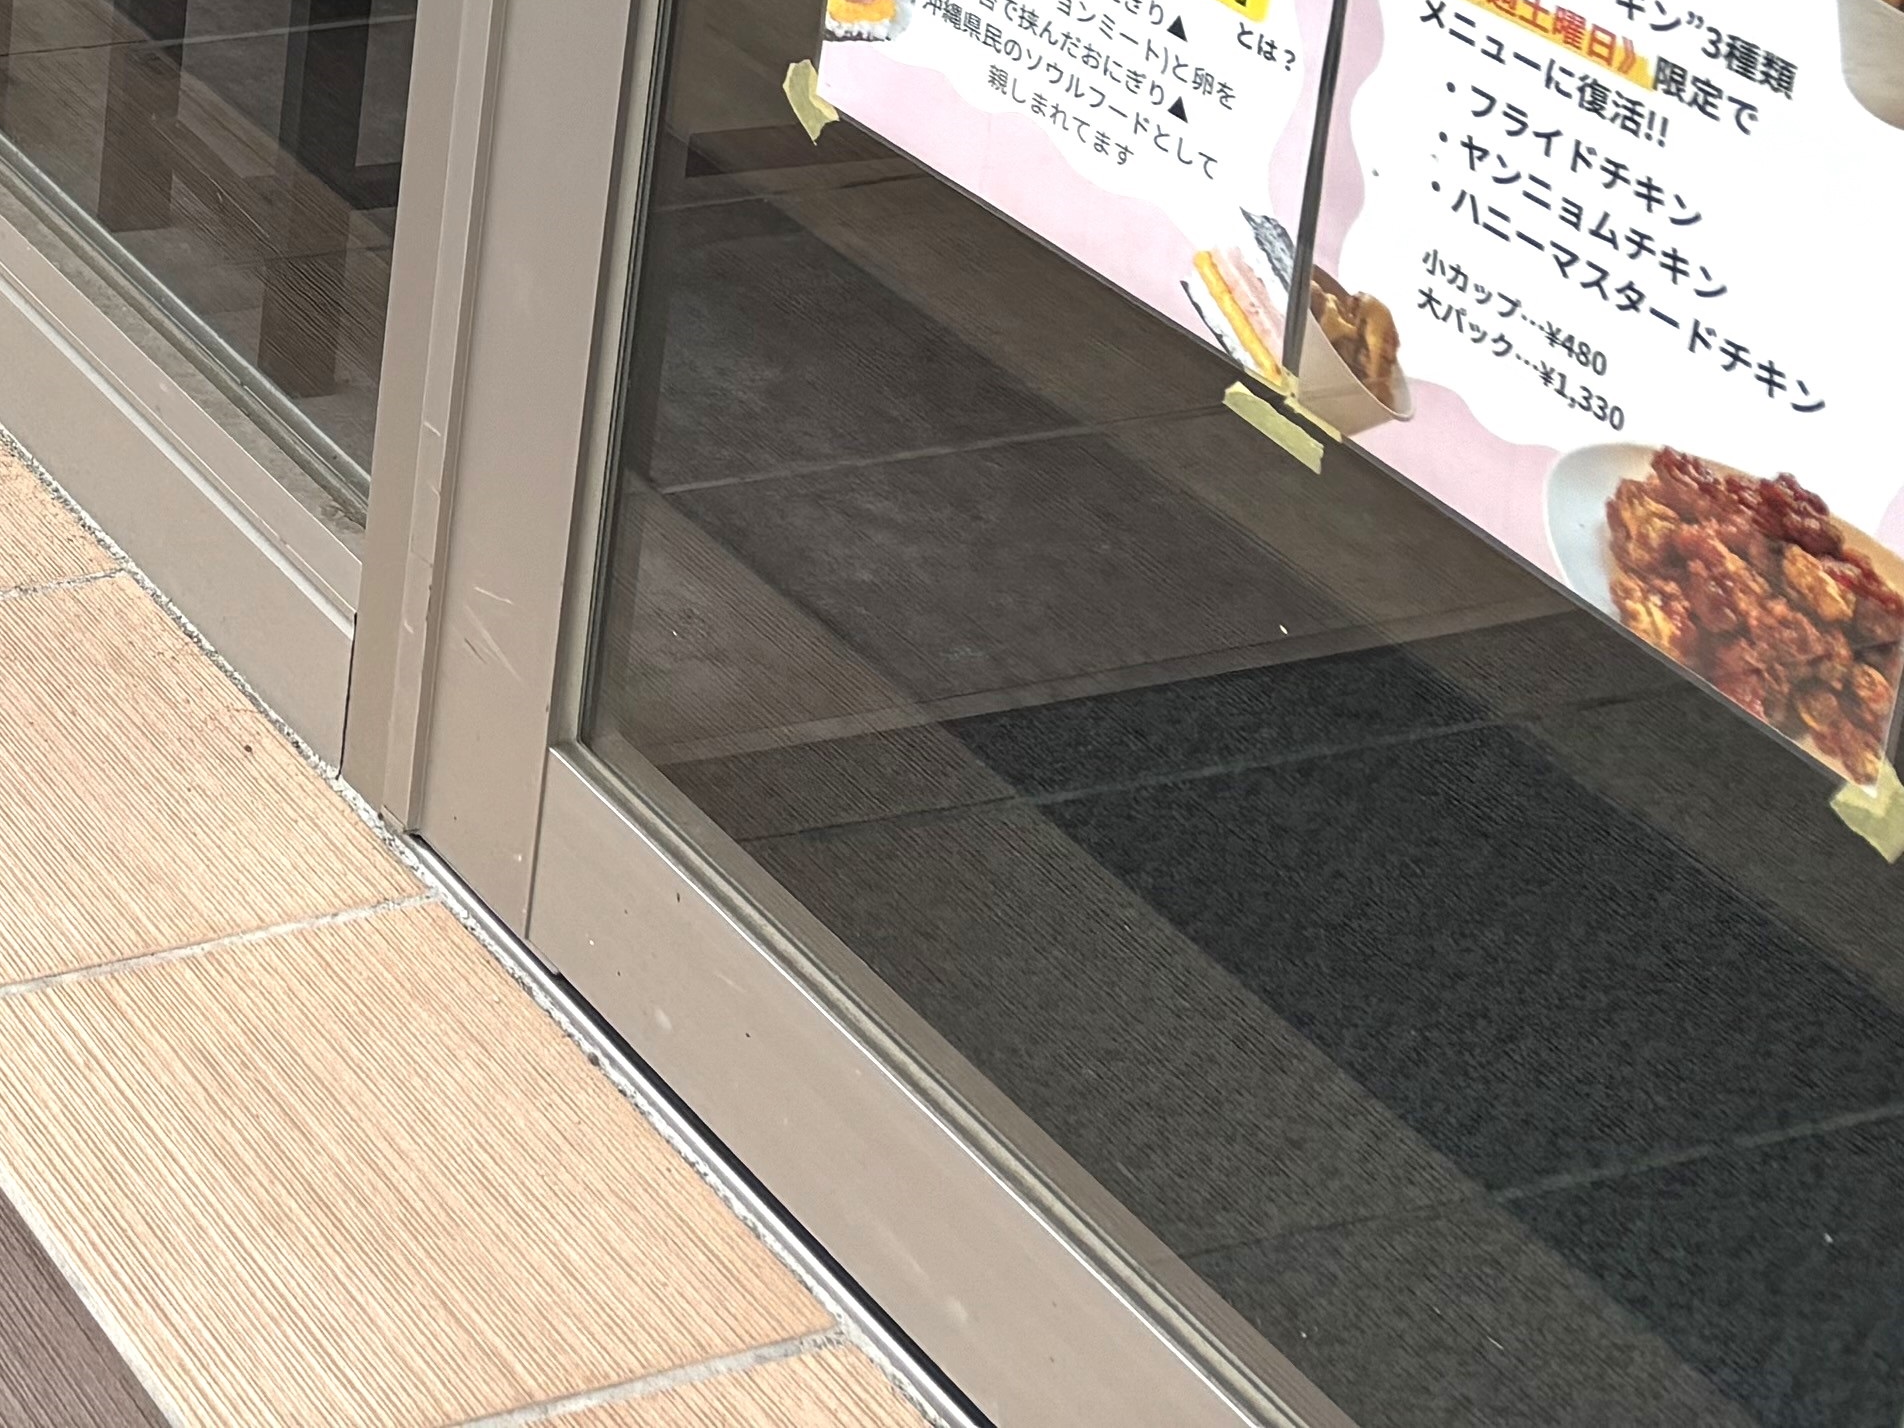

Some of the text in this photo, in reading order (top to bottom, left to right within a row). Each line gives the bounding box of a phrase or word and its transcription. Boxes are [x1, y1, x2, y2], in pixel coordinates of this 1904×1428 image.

[986, 63, 1135, 167] 親しまれてます
